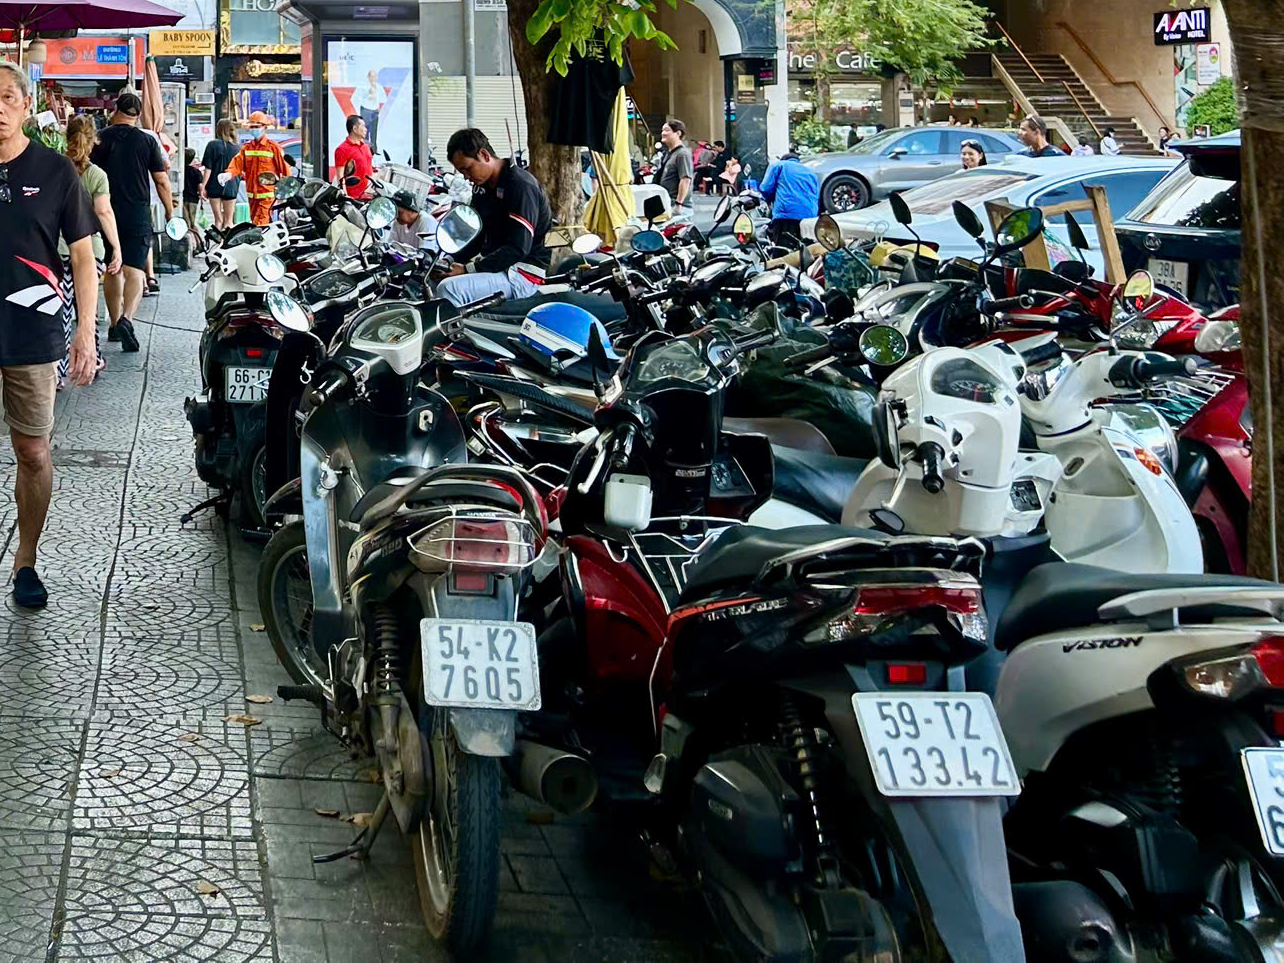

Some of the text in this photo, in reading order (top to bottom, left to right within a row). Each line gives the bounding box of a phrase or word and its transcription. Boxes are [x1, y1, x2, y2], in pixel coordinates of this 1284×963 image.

[1155, 9, 1206, 33] AVANTI
[163, 32, 212, 42] BABY SPOON
[787, 51, 814, 68] he
[437, 625, 519, 663] 54-K2
[1062, 635, 1145, 653] VISION
[440, 664, 523, 703] 7605
[875, 700, 981, 740] 59-T2
[877, 745, 1010, 788] 133.42
